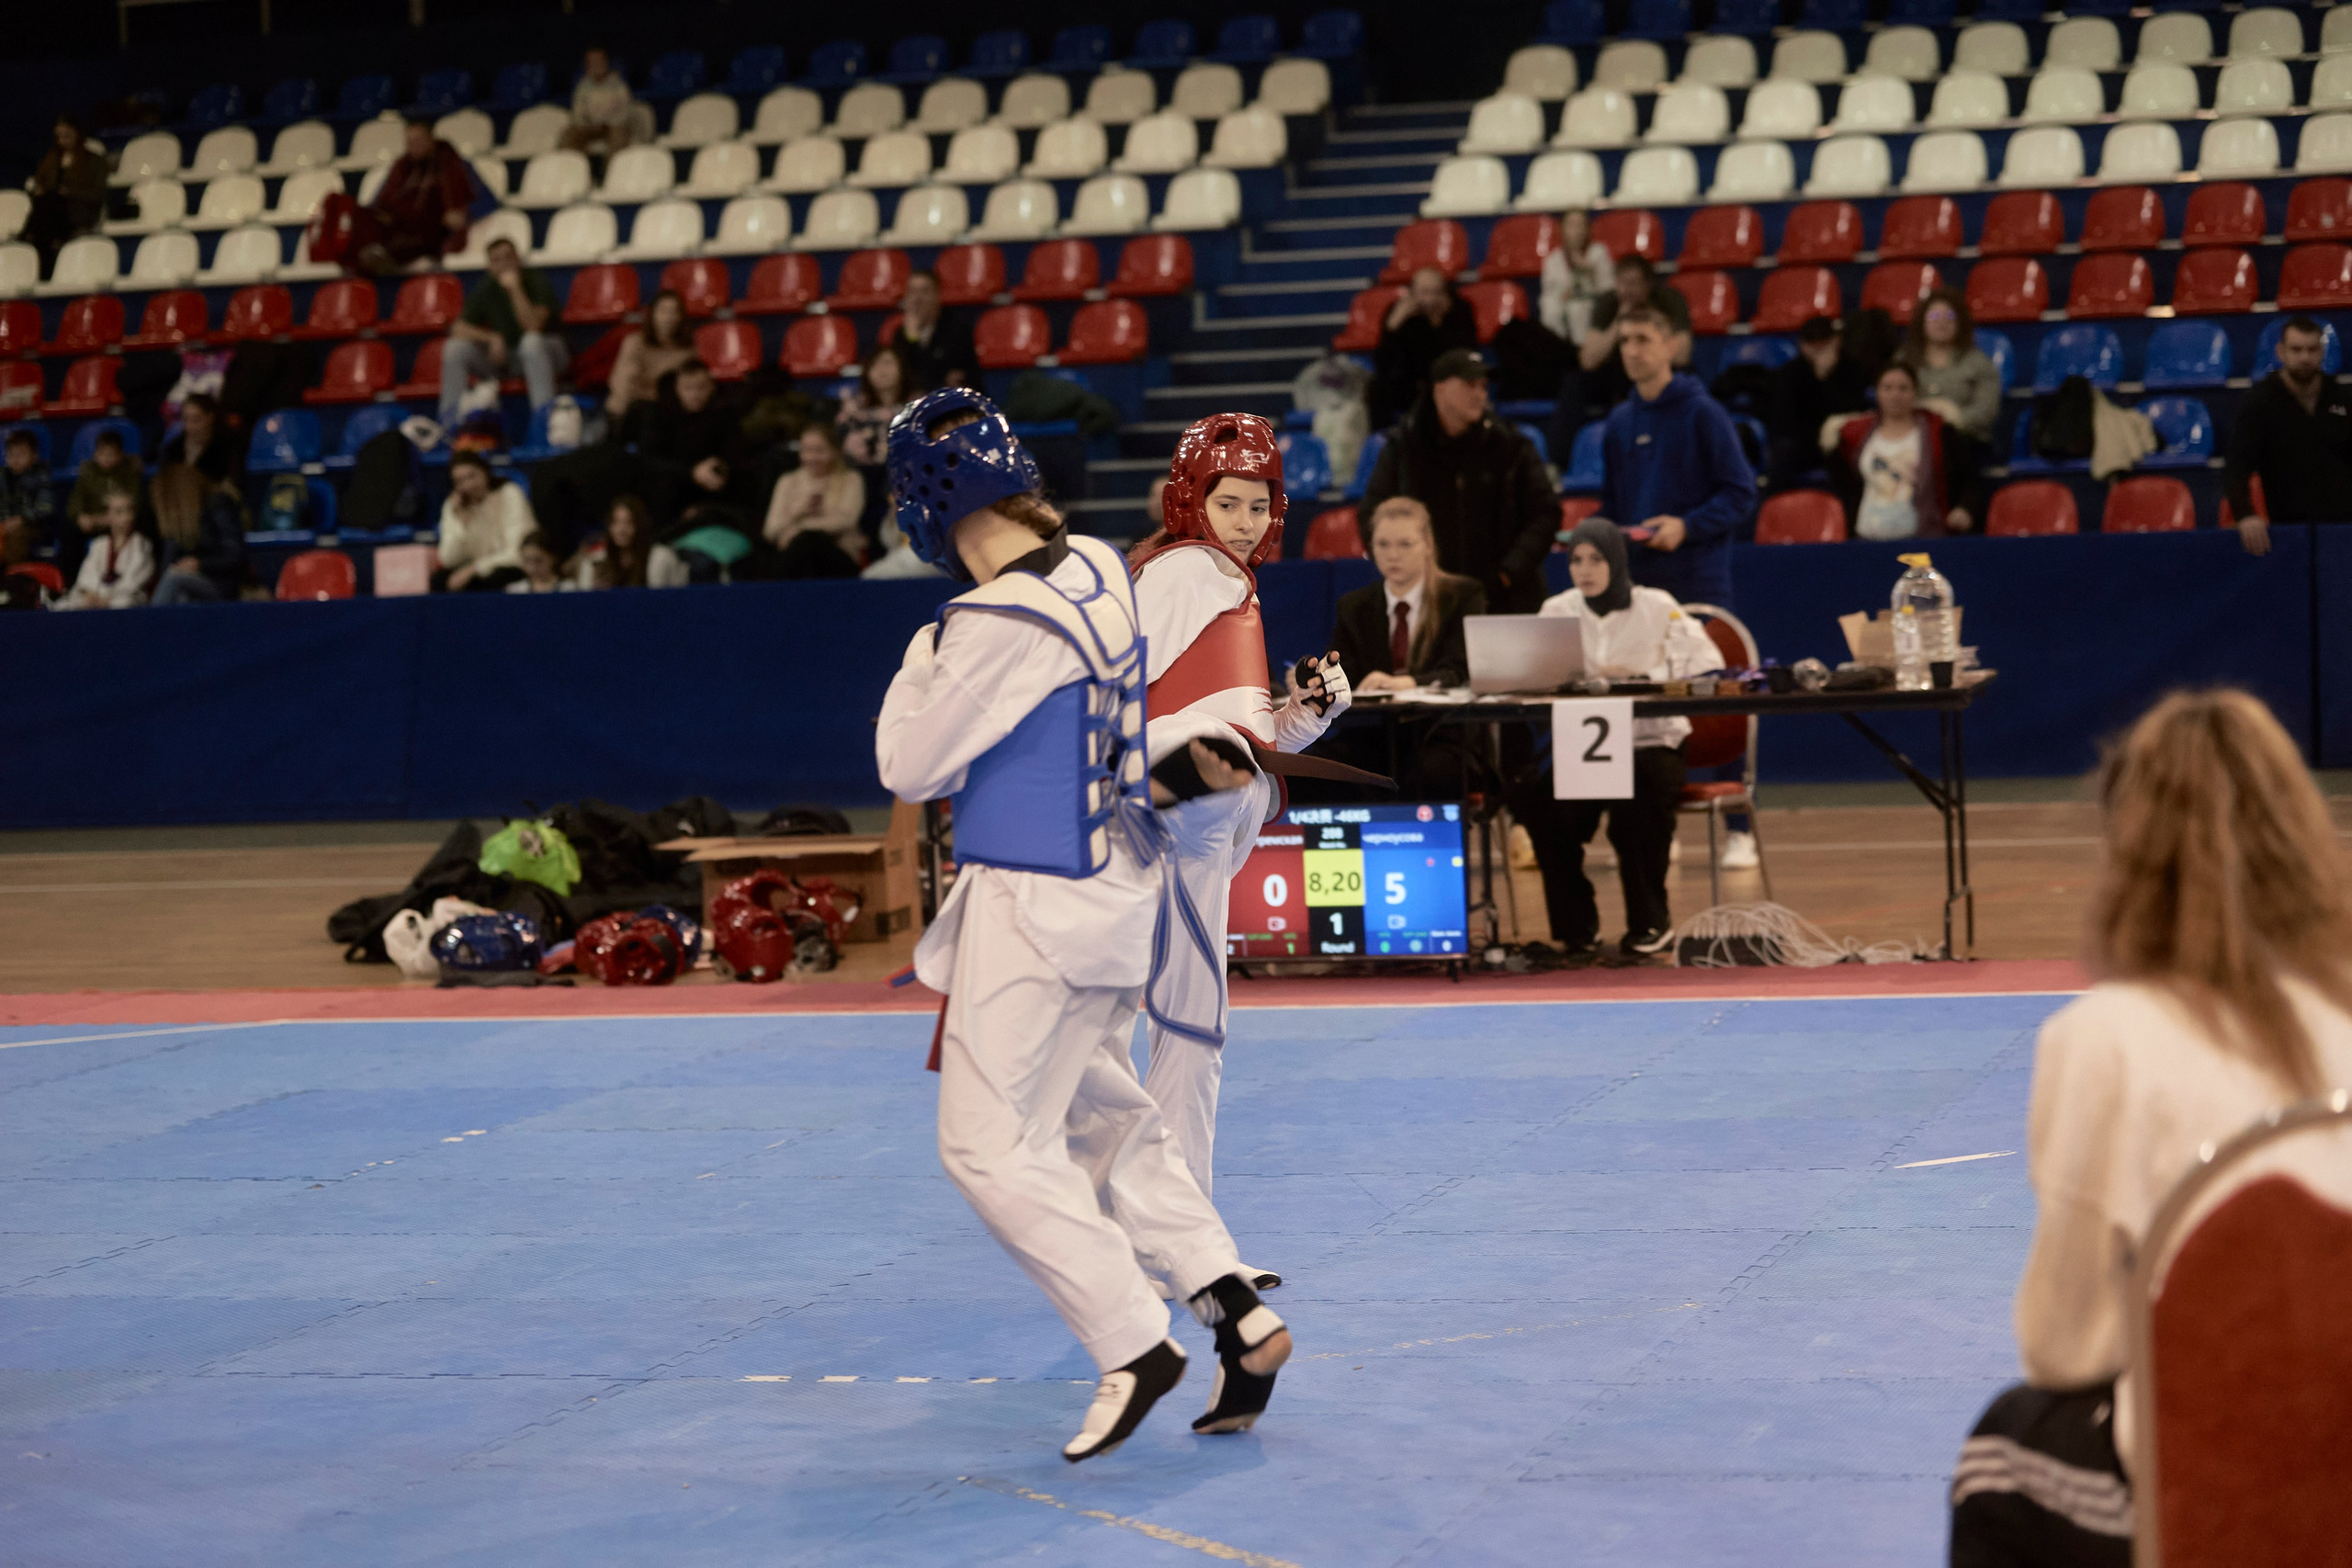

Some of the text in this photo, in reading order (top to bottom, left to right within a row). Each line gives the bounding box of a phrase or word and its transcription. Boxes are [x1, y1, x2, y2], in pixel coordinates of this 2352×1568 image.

[1582, 716, 1611, 761] 2
[1263, 874, 1288, 907] 0
[1309, 872, 1361, 896] 8,20
[1385, 871, 1407, 905] 5
[1329, 912, 1342, 935] 1
[1320, 942, 1356, 953] Round
